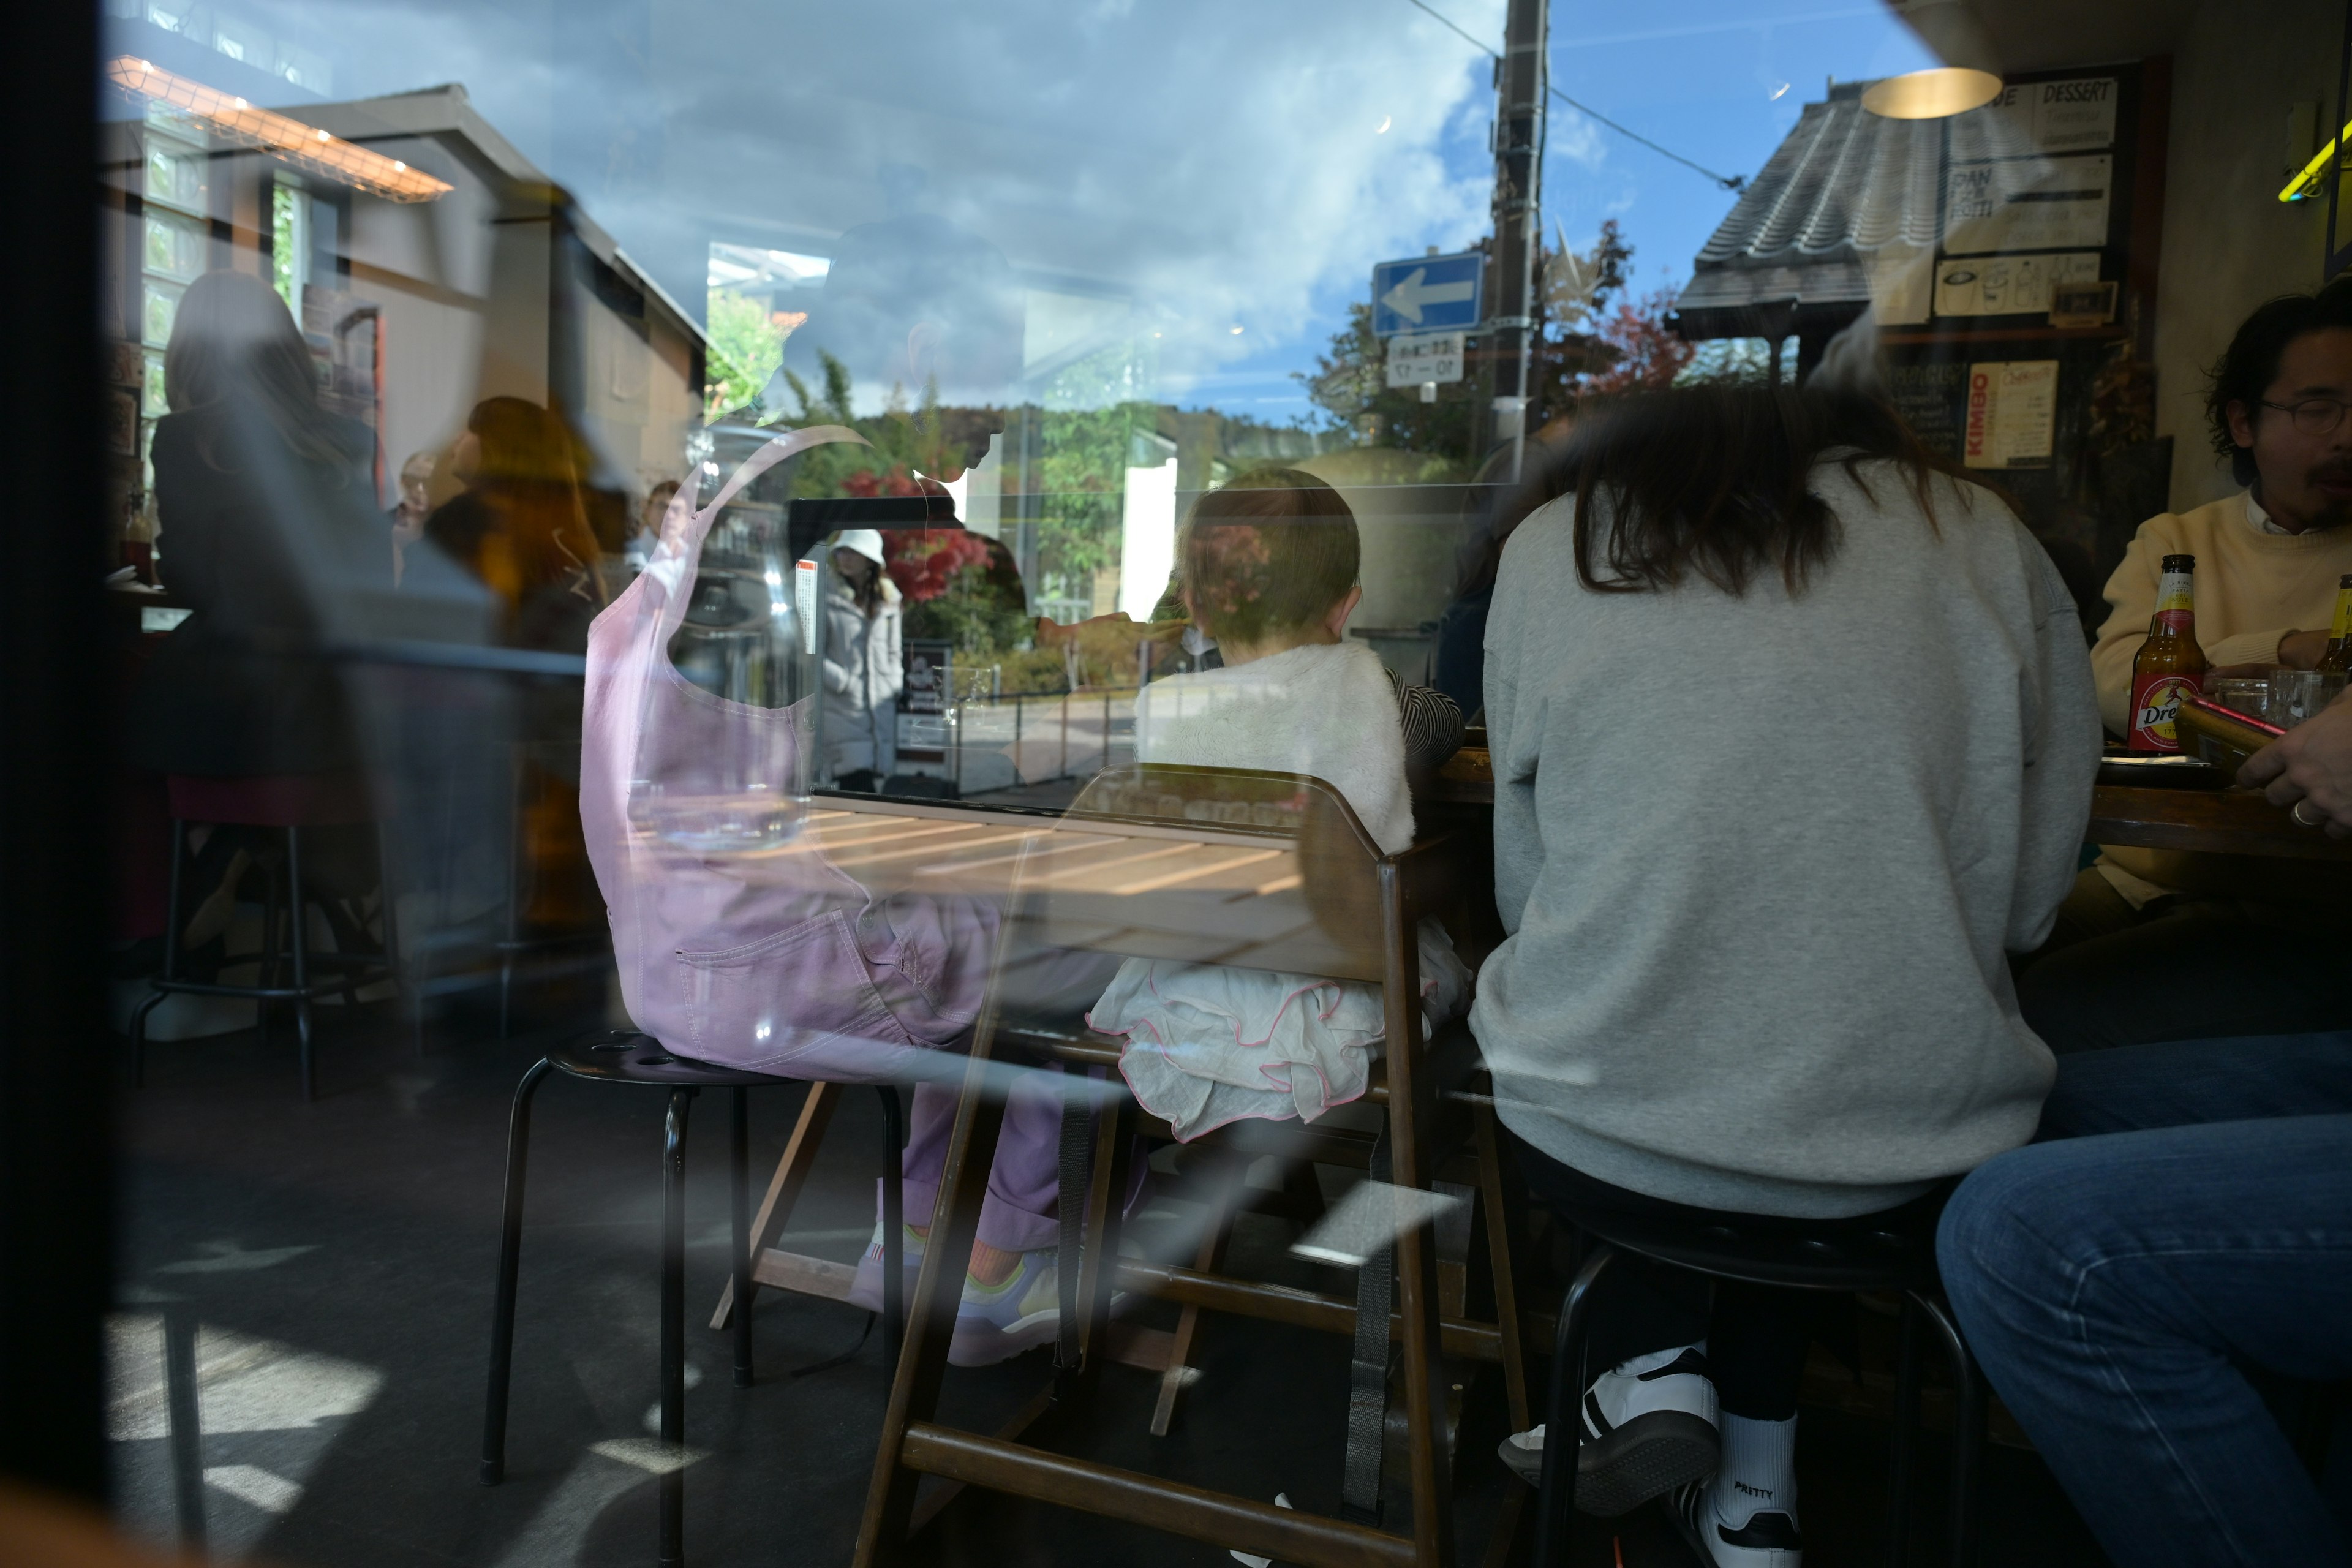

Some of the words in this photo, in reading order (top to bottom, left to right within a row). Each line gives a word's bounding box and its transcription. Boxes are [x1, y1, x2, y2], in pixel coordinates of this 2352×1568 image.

[2043, 81, 2112, 104] DESSERT
[1967, 374, 1989, 456] KIMBO
[2143, 706, 2177, 725] Dre
[1735, 1480, 1773, 1500] PRETTY
